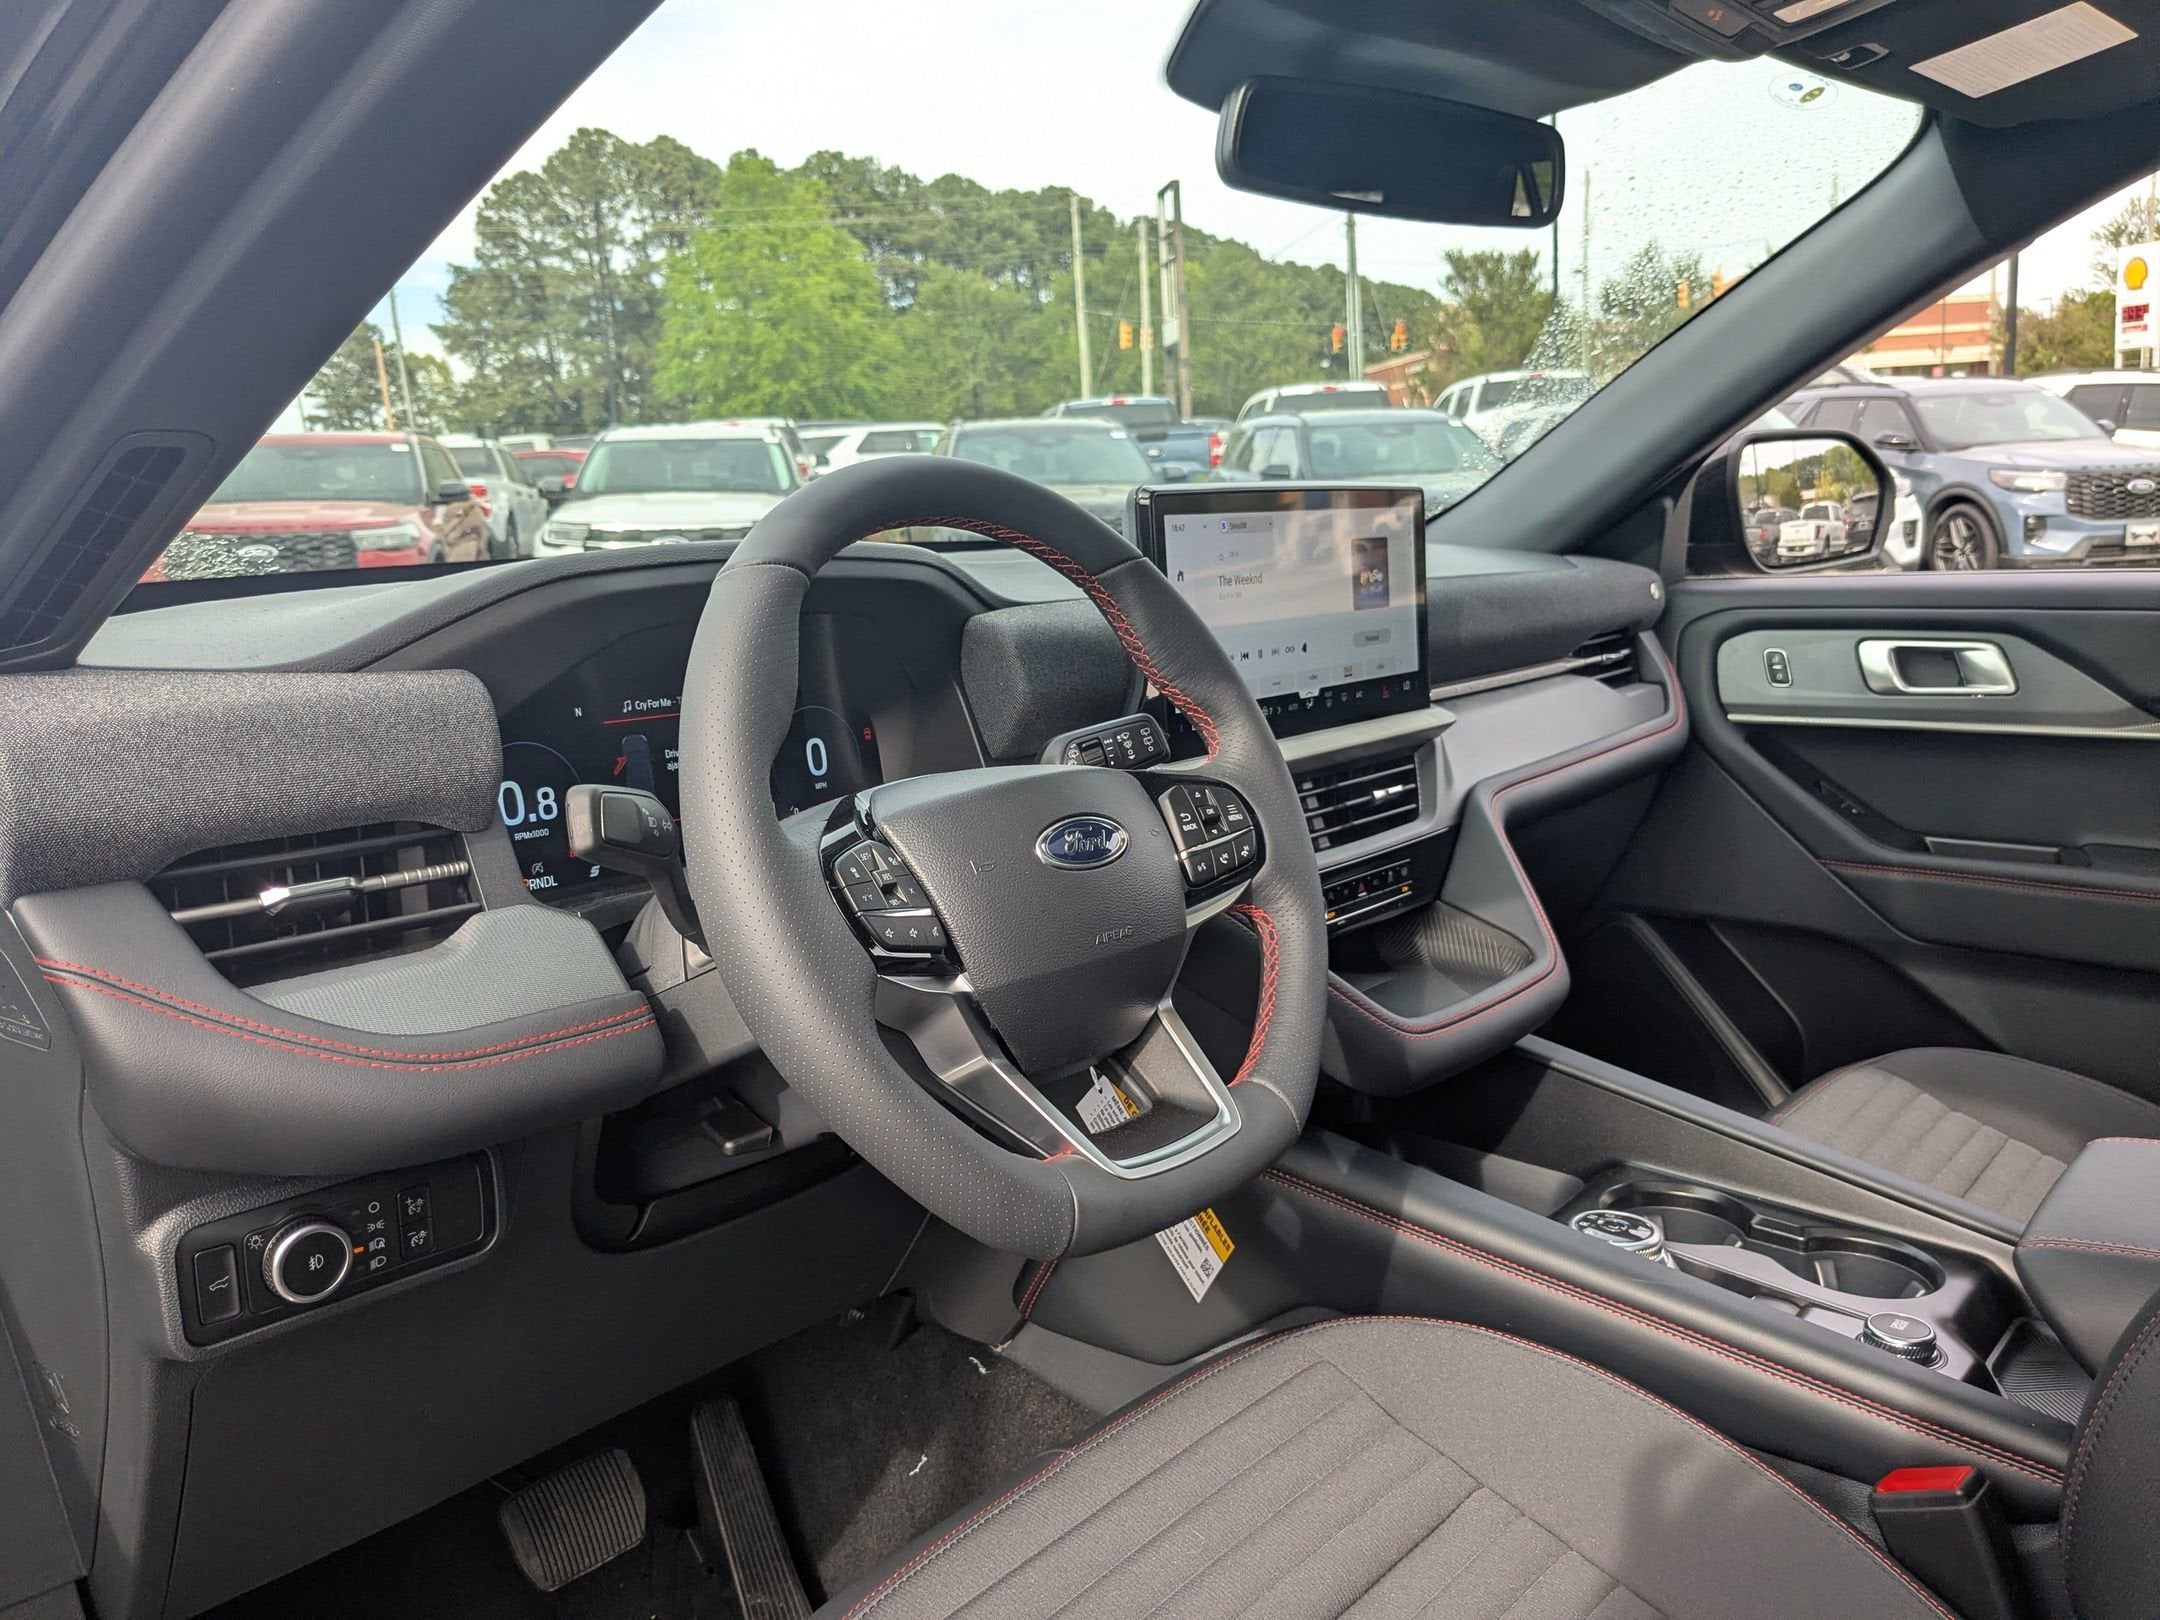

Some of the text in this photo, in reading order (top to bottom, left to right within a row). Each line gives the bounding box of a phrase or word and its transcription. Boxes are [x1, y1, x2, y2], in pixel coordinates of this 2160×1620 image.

[1218, 573, 1263, 587] The Weeknd
[635, 701, 647, 711] Cry
[647, 699, 659, 709] For
[660, 698, 672, 708] Me
[574, 707, 583, 718] N
[805, 737, 828, 777] 0
[814, 781, 828, 790] MPH
[498, 780, 558, 826] 0.8
[1183, 823, 1198, 832] BACK
[514, 828, 550, 841] RPMx1000
[1064, 825, 1109, 856] Ford
[881, 872, 893, 881] RES
